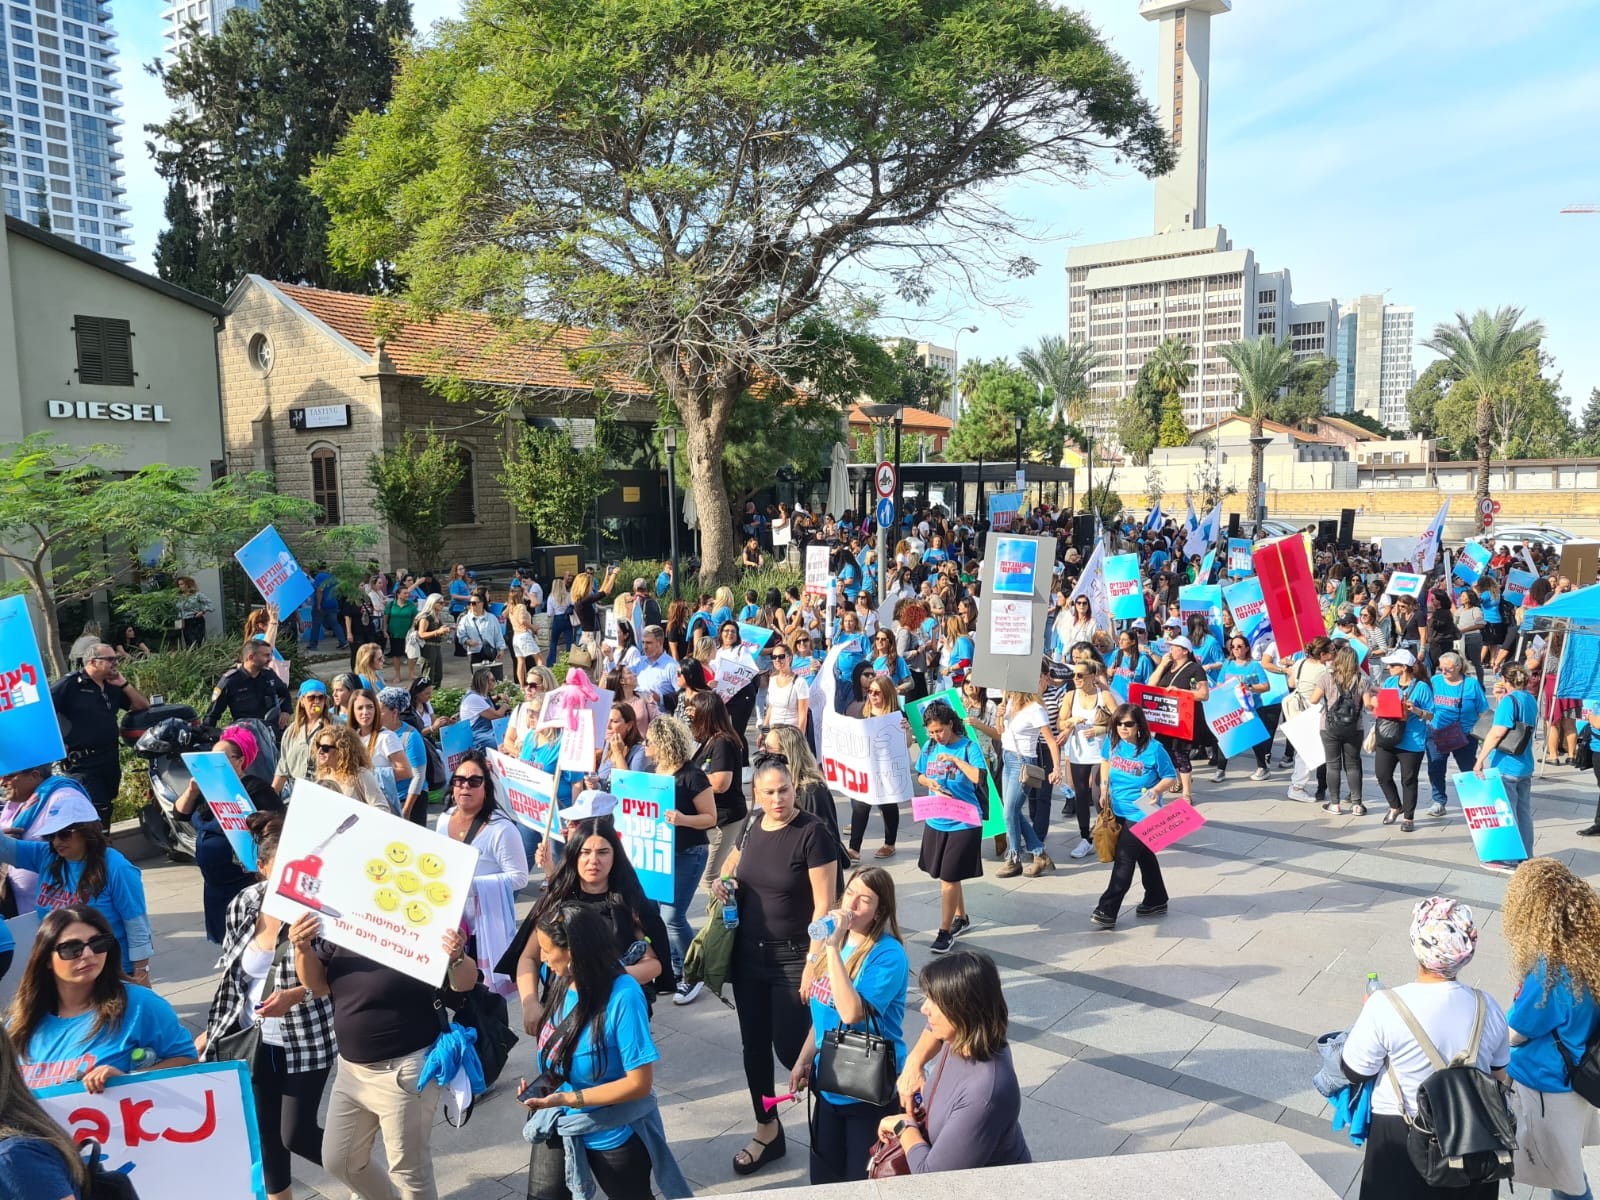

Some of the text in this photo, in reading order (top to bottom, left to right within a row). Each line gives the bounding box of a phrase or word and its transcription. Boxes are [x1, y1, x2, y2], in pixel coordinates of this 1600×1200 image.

[48, 400, 171, 422] DIESEL
[622, 798, 658, 818] רוצים
[333, 918, 430, 964] לא עובדים חינם יותר
[409, 931, 420, 942] די
